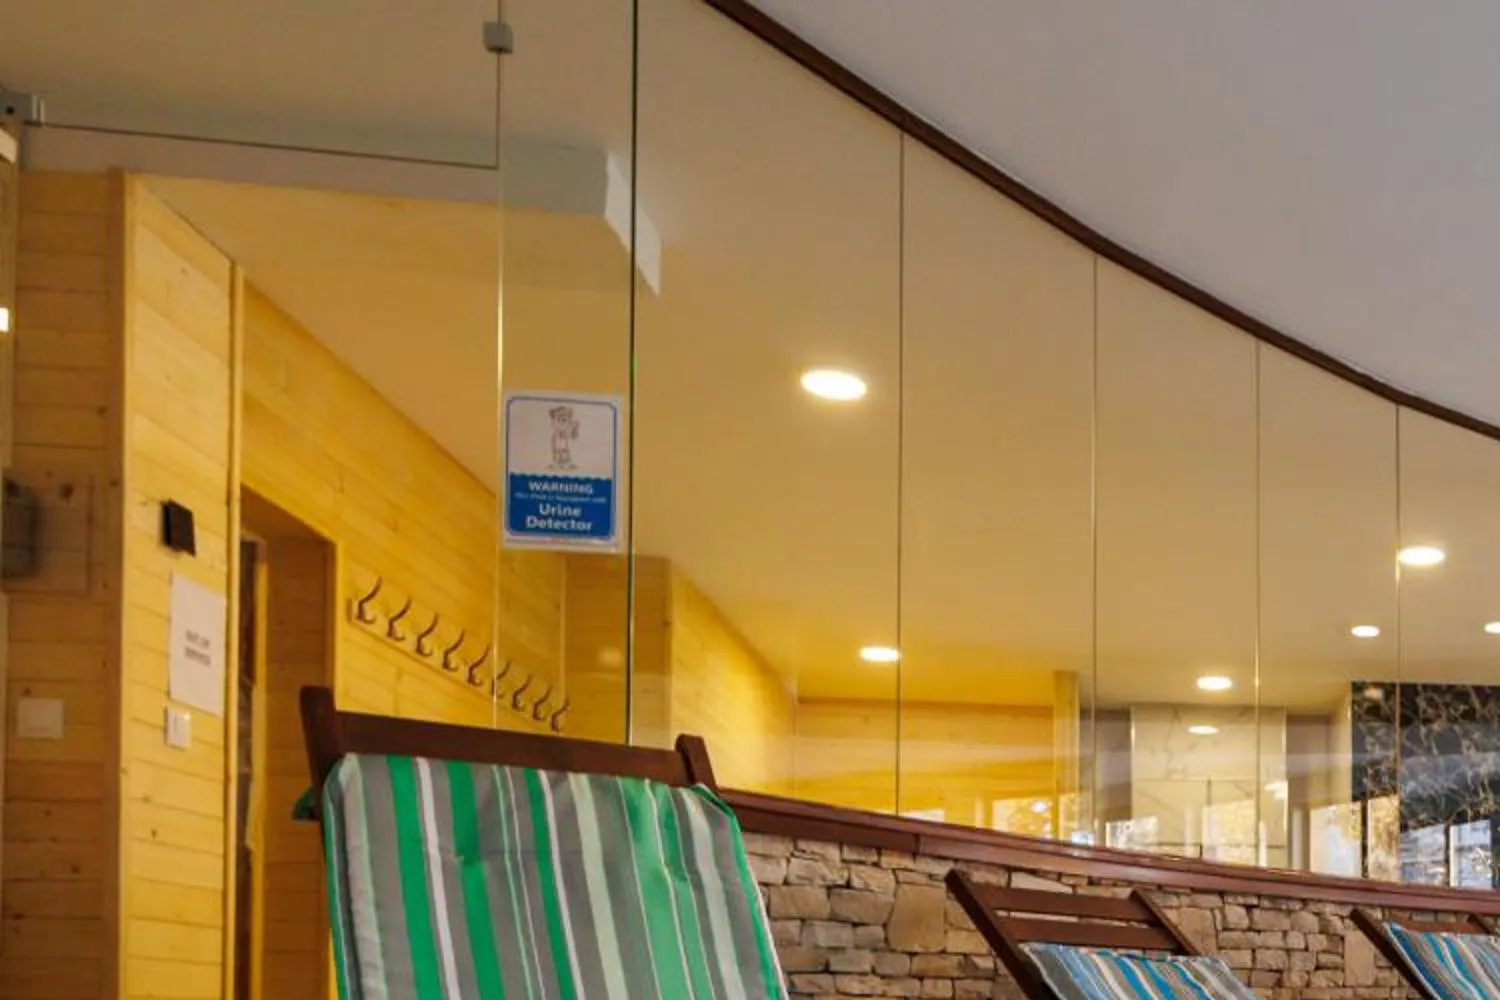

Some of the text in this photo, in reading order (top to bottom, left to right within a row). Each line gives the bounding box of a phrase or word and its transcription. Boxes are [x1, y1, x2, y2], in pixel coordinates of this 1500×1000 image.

[529, 481, 593, 494] WARNING
[539, 503, 581, 516] Urine
[526, 516, 592, 530] Detector
